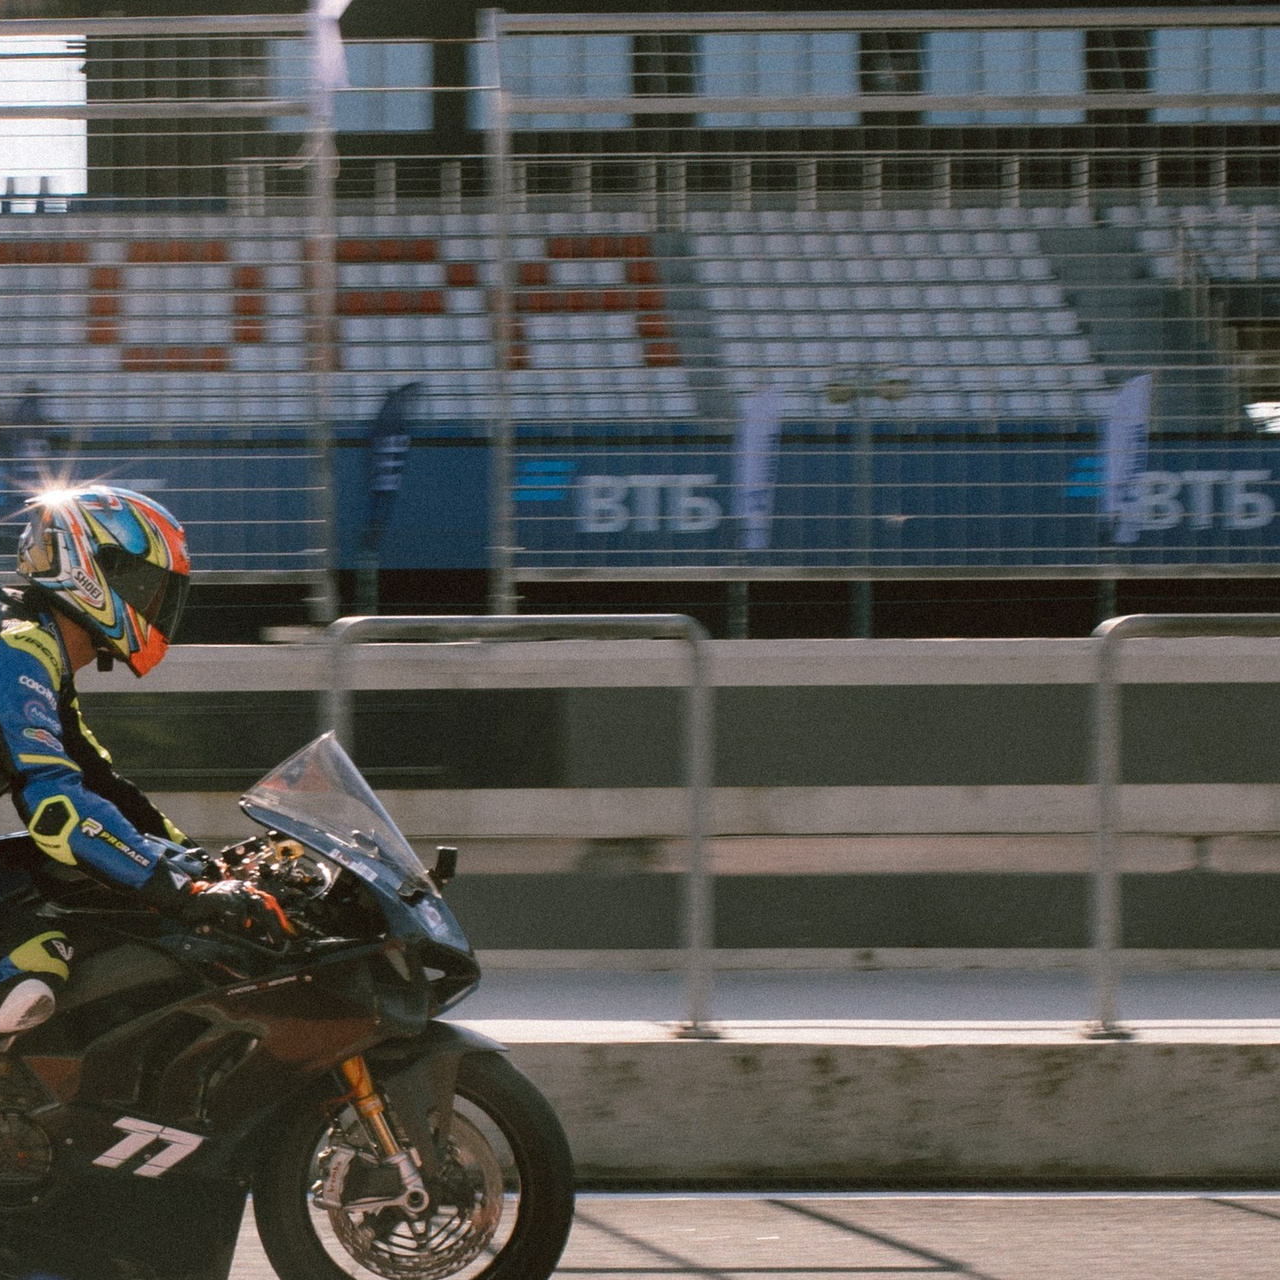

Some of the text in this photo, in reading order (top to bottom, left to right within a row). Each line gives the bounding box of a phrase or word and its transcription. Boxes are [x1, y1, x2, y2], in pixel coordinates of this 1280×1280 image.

[575, 473, 722, 534] ВТБ
[1132, 469, 1278, 532] ВТБ
[73, 570, 104, 601] SHOEI
[99, 829, 151, 868] PRORACE
[91, 1115, 204, 1178] 77
